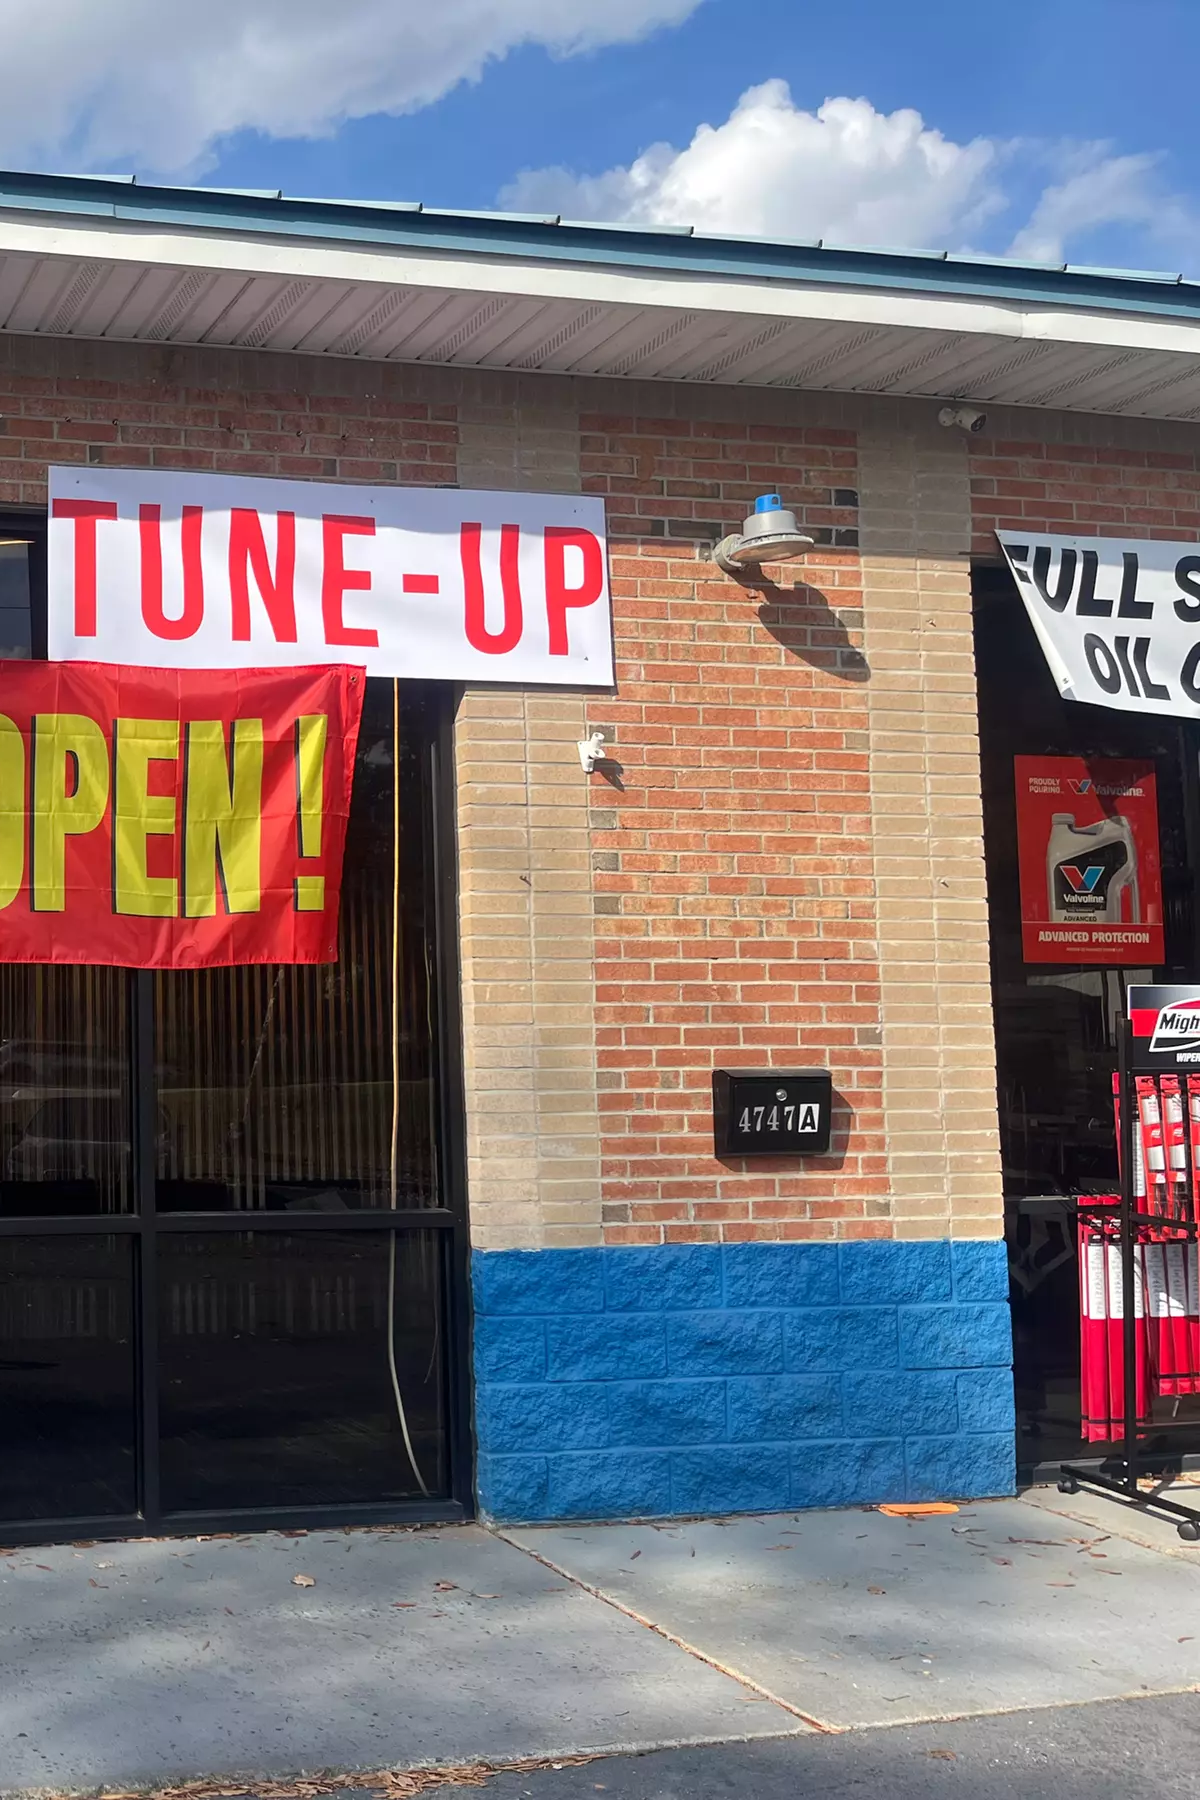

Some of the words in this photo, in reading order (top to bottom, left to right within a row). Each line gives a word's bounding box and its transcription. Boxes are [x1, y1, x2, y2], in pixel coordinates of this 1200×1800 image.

[52, 498, 603, 656] TUNE-UP
[1084, 632, 1171, 700] OIL
[1063, 893, 1104, 903] Valvoline
[1038, 931, 1089, 942] ADVANCED
[1092, 932, 1150, 943] PROTECTION
